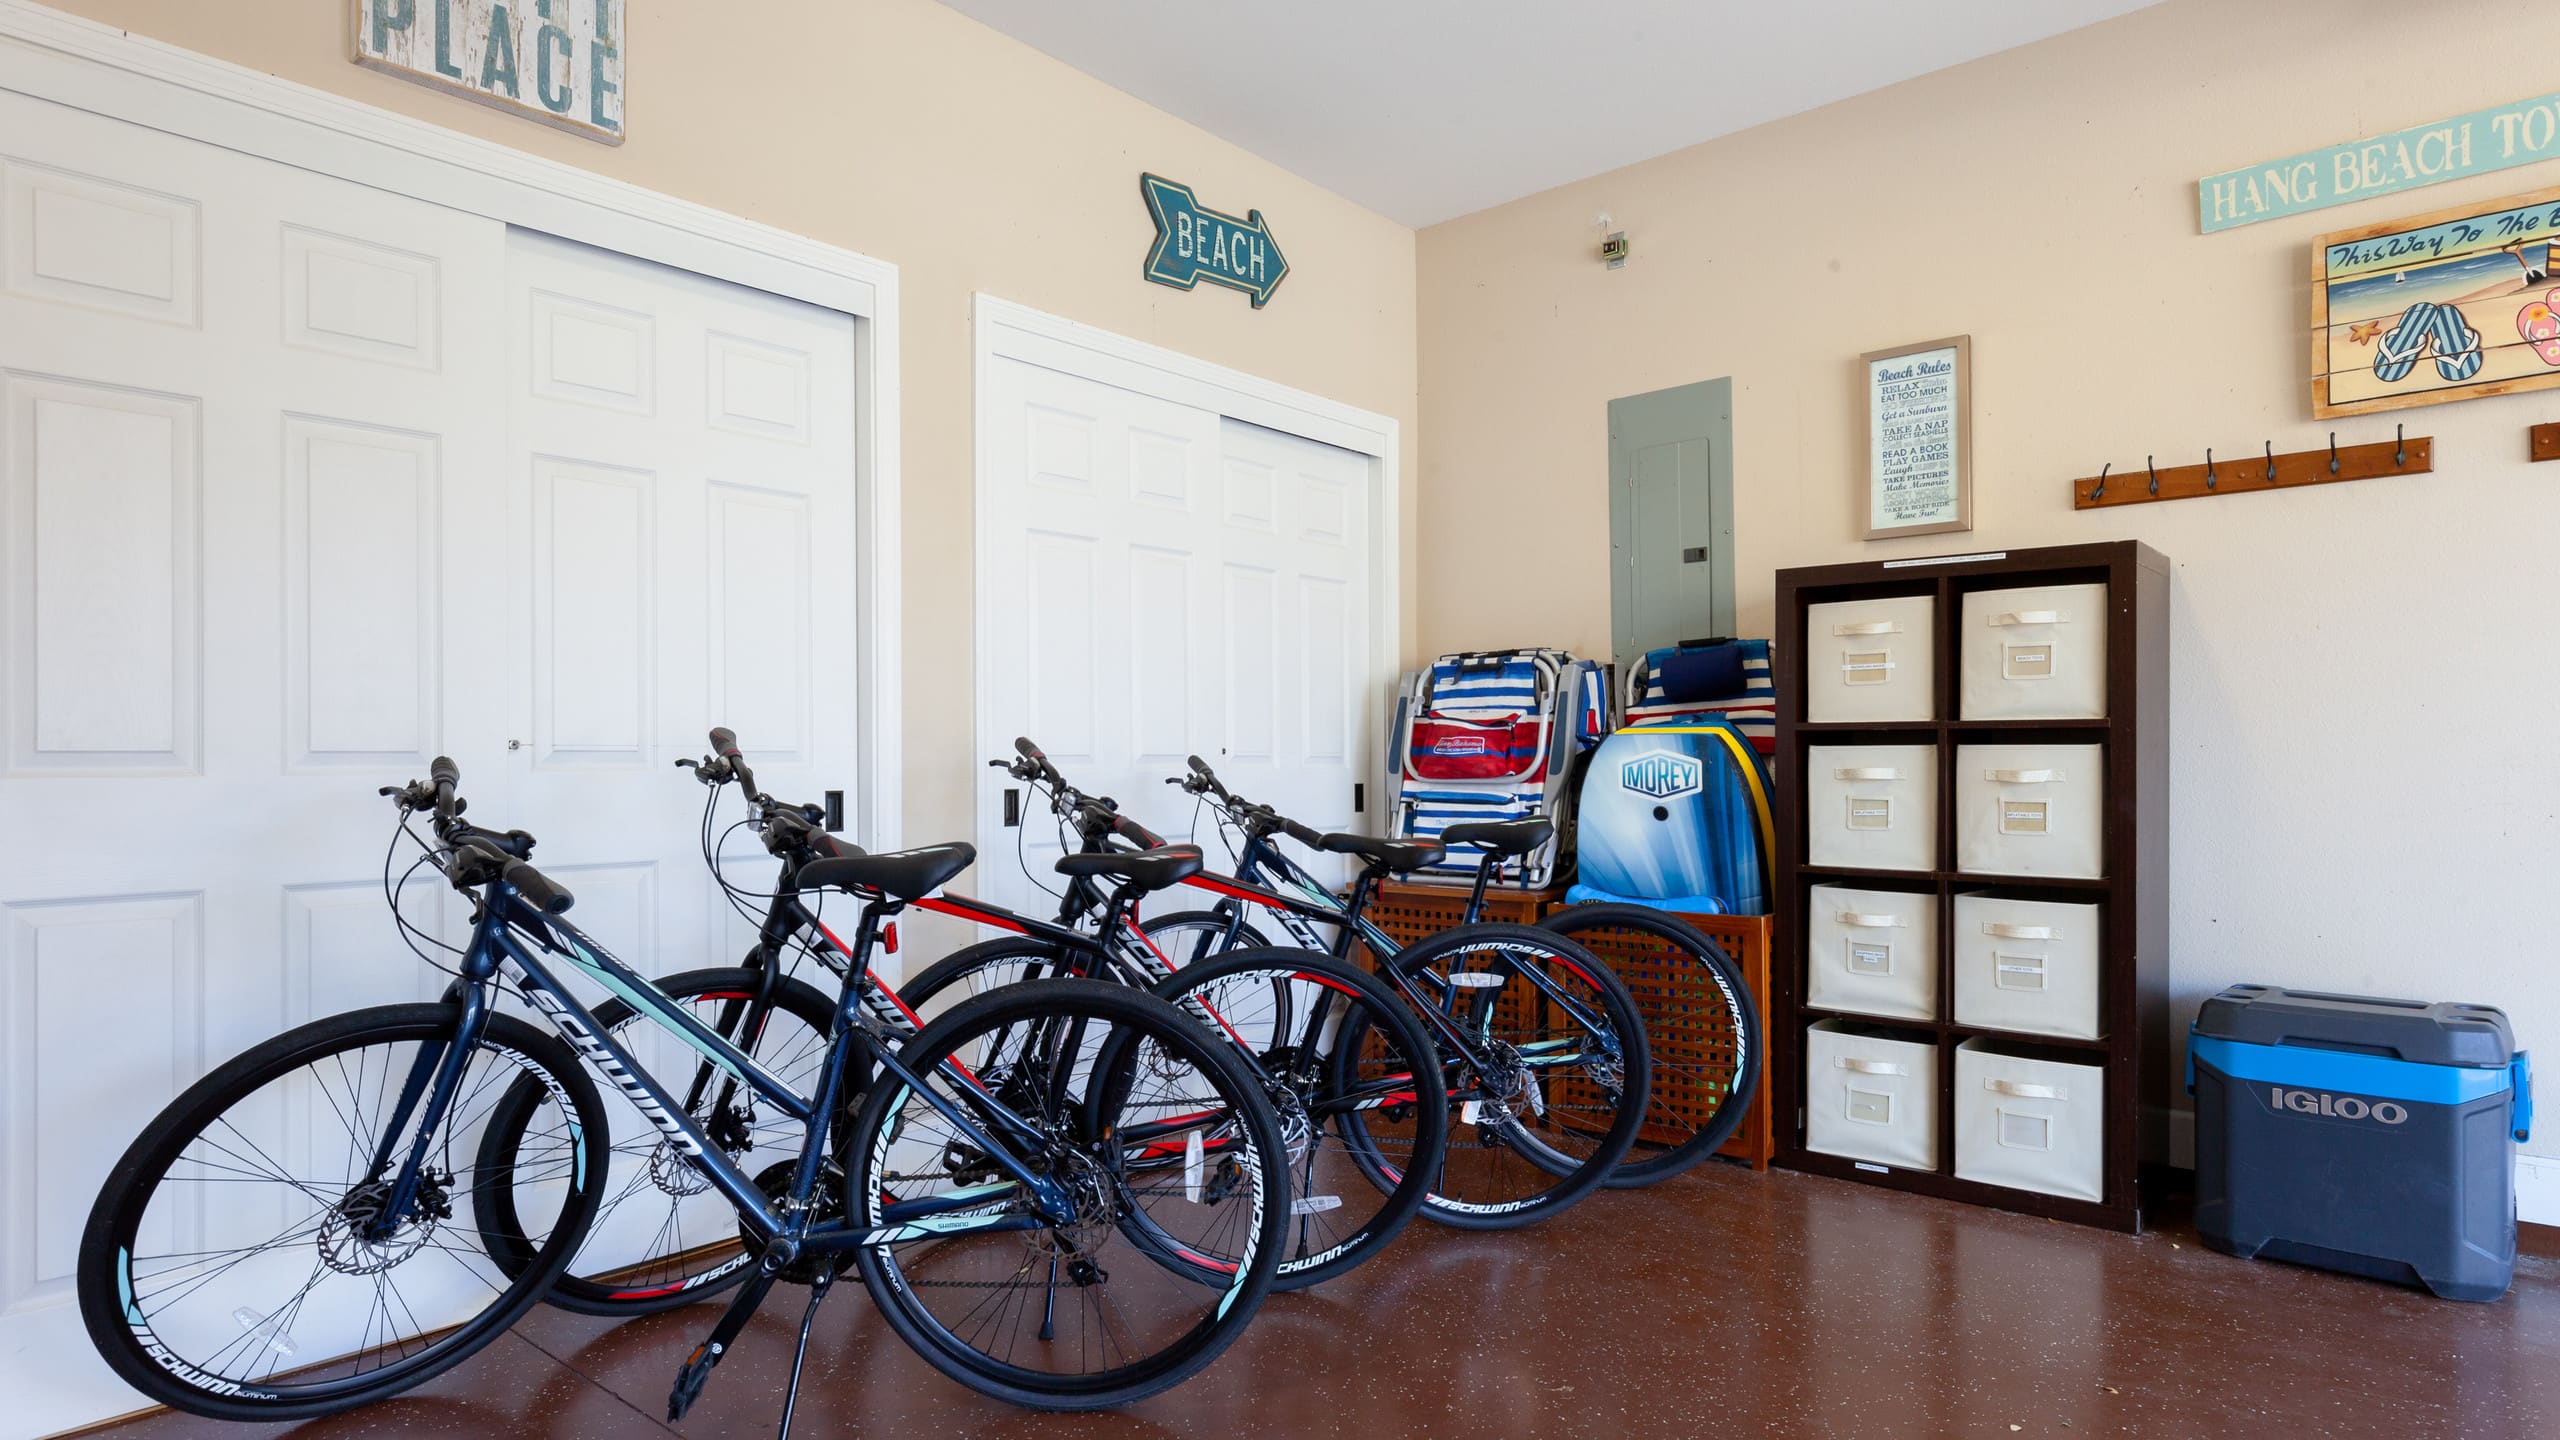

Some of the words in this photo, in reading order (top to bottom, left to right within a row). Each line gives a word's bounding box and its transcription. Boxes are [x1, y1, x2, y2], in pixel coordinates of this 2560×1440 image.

[373, 0, 618, 132] PLACE
[2211, 161, 2317, 223] HANG
[2333, 121, 2473, 195] BEACH
[2492, 101, 2560, 158] TO
[1177, 210, 1265, 283] BEACH
[2333, 244, 2386, 268] This
[2387, 233, 2444, 257] Way
[2451, 224, 2485, 247] To
[2496, 212, 2540, 237] The
[1878, 365, 1914, 382] Beach
[1916, 360, 1952, 376] Rules
[1881, 394, 1895, 403] EAT
[1898, 390, 1917, 400] TOO
[1919, 386, 1948, 397] MUCH
[1882, 382, 1920, 395] RELAX
[1881, 411, 1898, 423] Get
[1882, 425, 1912, 436] TAKE
[1914, 423, 1922, 432] A
[1924, 420, 1949, 430] NAP
[1882, 448, 1907, 460] READ
[1910, 447, 1917, 455] A
[1919, 442, 1949, 454] BOOK
[1883, 457, 1908, 468] PLAY
[1911, 451, 1949, 463] GAMES
[1883, 474, 1905, 485] TAKE
[1907, 470, 1949, 481] PICTURES
[1627, 757, 1693, 794] MOREY
[1459, 942, 1536, 954] SCHWINN
[1189, 969, 1272, 998] SCHWINN
[1714, 974, 1745, 1038] SCHWINN
[500, 1047, 573, 1104] SCHWINN
[527, 988, 703, 1157] SCHWINN
[2271, 1087, 2408, 1125] IGLOO
[1245, 1143, 1264, 1244] SCHWINN
[1448, 1200, 1521, 1214] SCHWINN
[1276, 1244, 1343, 1274] CHWINN
[145, 1343, 241, 1396] SCHWINN
